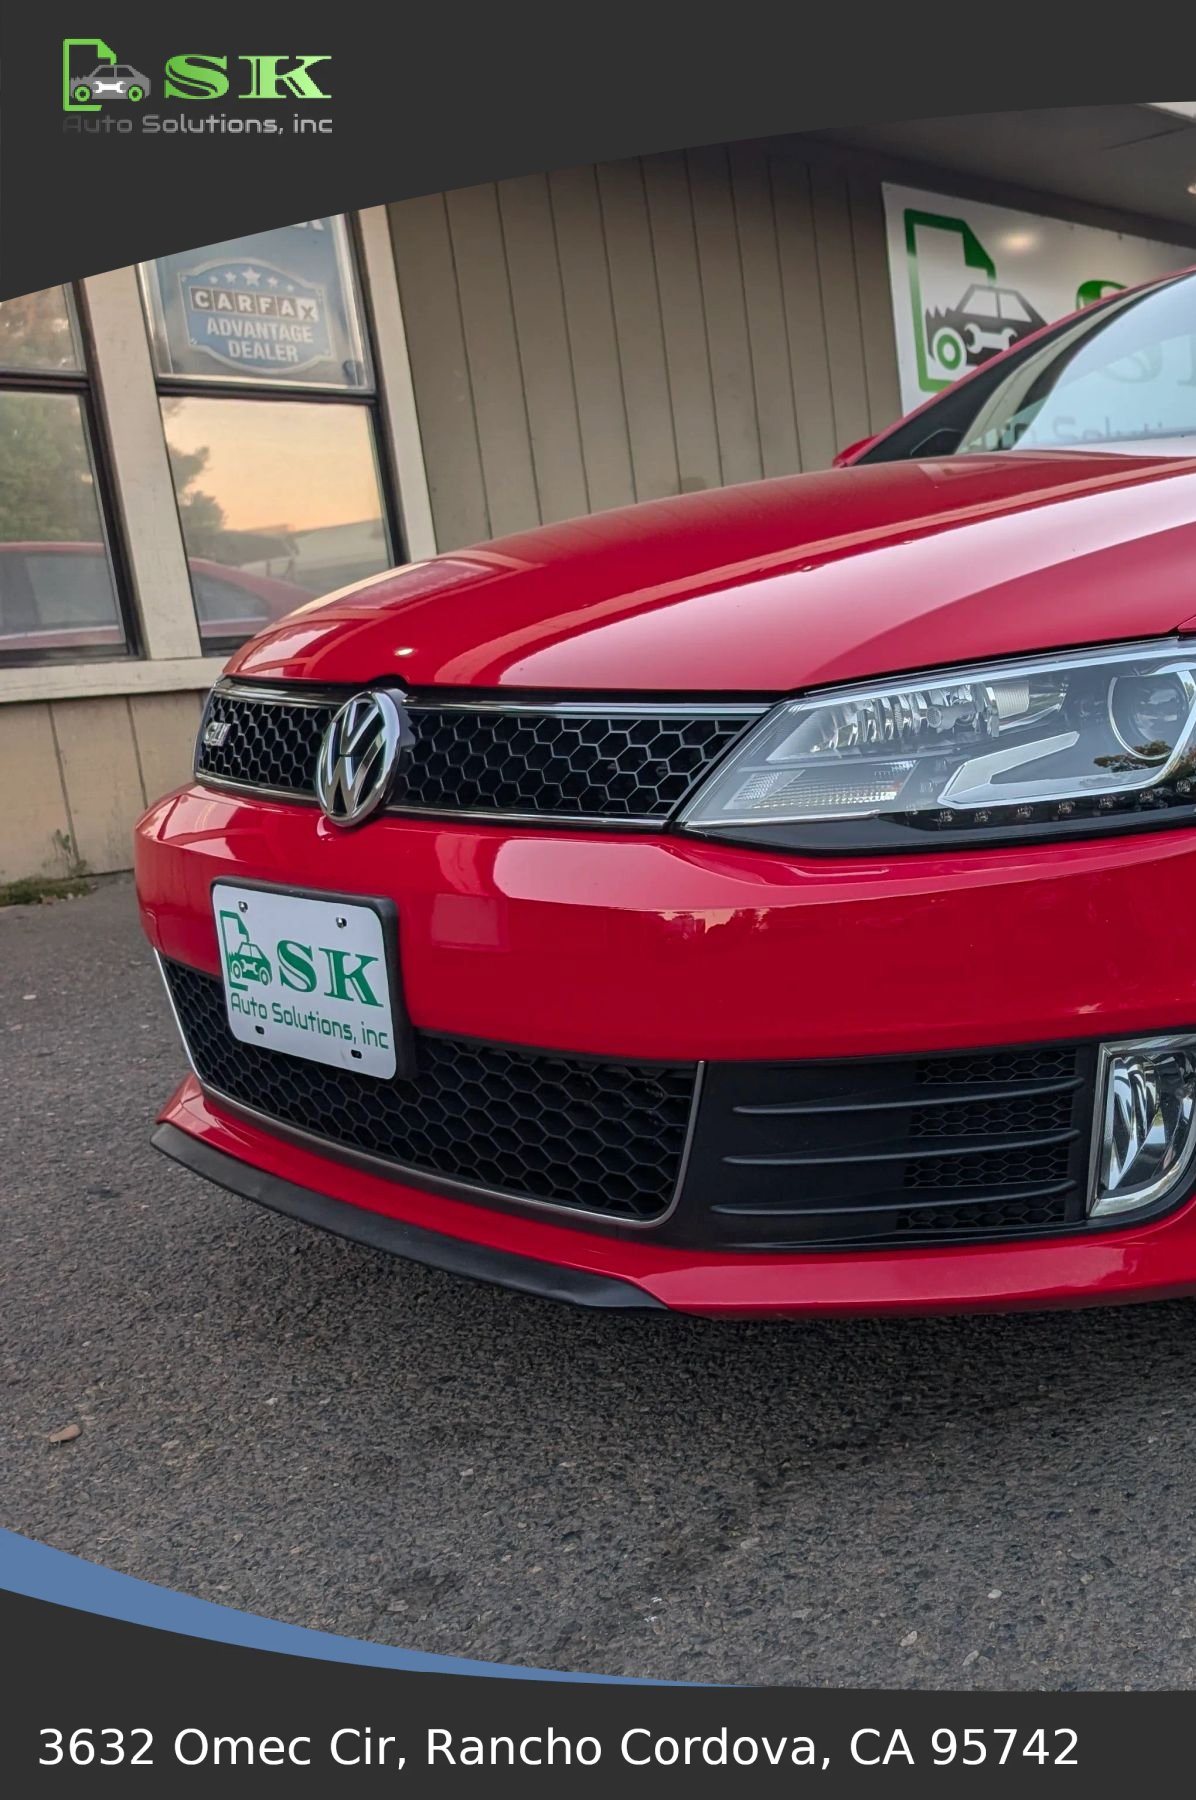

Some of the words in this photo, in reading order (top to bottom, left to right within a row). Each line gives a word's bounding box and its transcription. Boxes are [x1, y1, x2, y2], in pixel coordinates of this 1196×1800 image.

[194, 289, 317, 321] CARFAX
[207, 317, 314, 343] ADVANTAGE
[228, 339, 299, 362] DEALER
[276, 939, 384, 1008] SK
[230, 992, 268, 1020] Auto
[271, 1002, 358, 1045] Solutions,
[361, 1021, 389, 1049] inc
